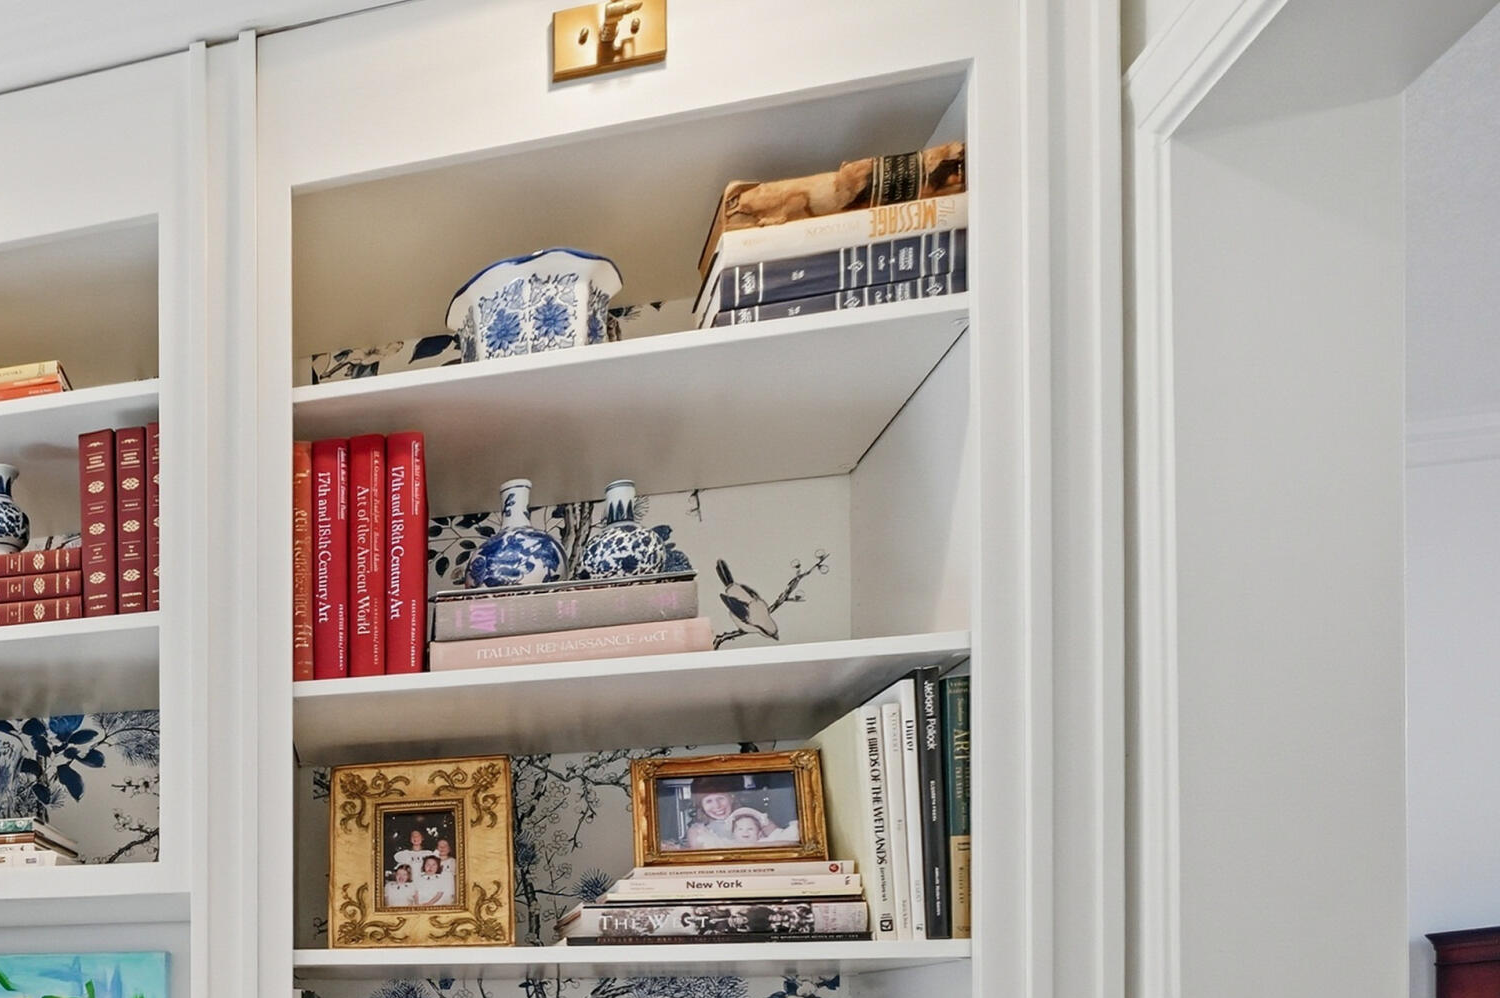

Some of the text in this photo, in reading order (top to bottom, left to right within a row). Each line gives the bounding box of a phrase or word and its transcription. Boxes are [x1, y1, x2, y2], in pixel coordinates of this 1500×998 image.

[868, 199, 937, 238] MESSAGE
[316, 472, 332, 623] 17th and 18th Century Art
[357, 485, 371, 635] Art of the Ancient World
[387, 466, 405, 620] 17th and 18th Century Art
[476, 645, 533, 661] ITALIAN
[535, 633, 636, 655] RENAISSANCE
[925, 718, 937, 751] Pollock
[866, 716, 887, 865] THE BIRDS OF THE WETLANDS
[685, 879, 743, 889] New York
[600, 914, 711, 931] THE WEST
